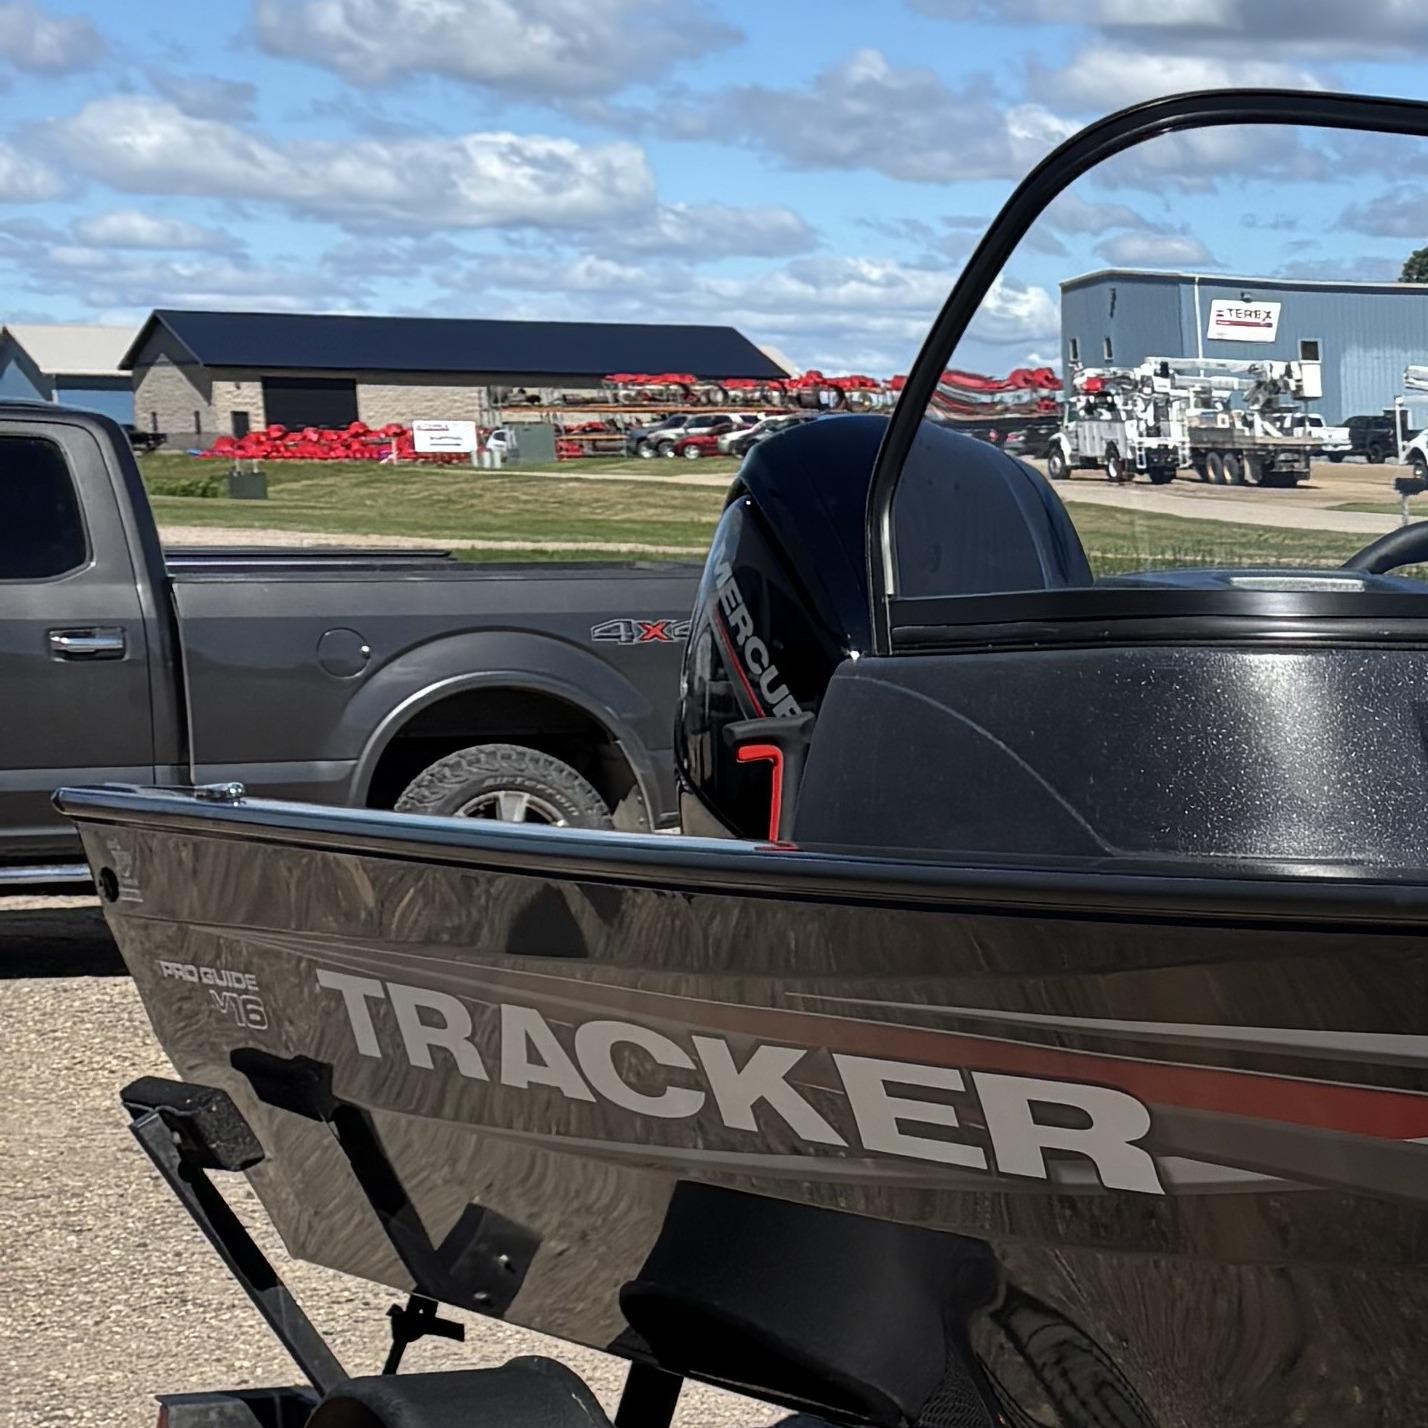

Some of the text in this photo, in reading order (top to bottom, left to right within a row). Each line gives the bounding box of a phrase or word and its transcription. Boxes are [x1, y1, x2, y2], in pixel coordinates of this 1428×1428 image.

[159, 960, 260, 992] PRO GUIDE
[315, 967, 1166, 1196] TRACKER
